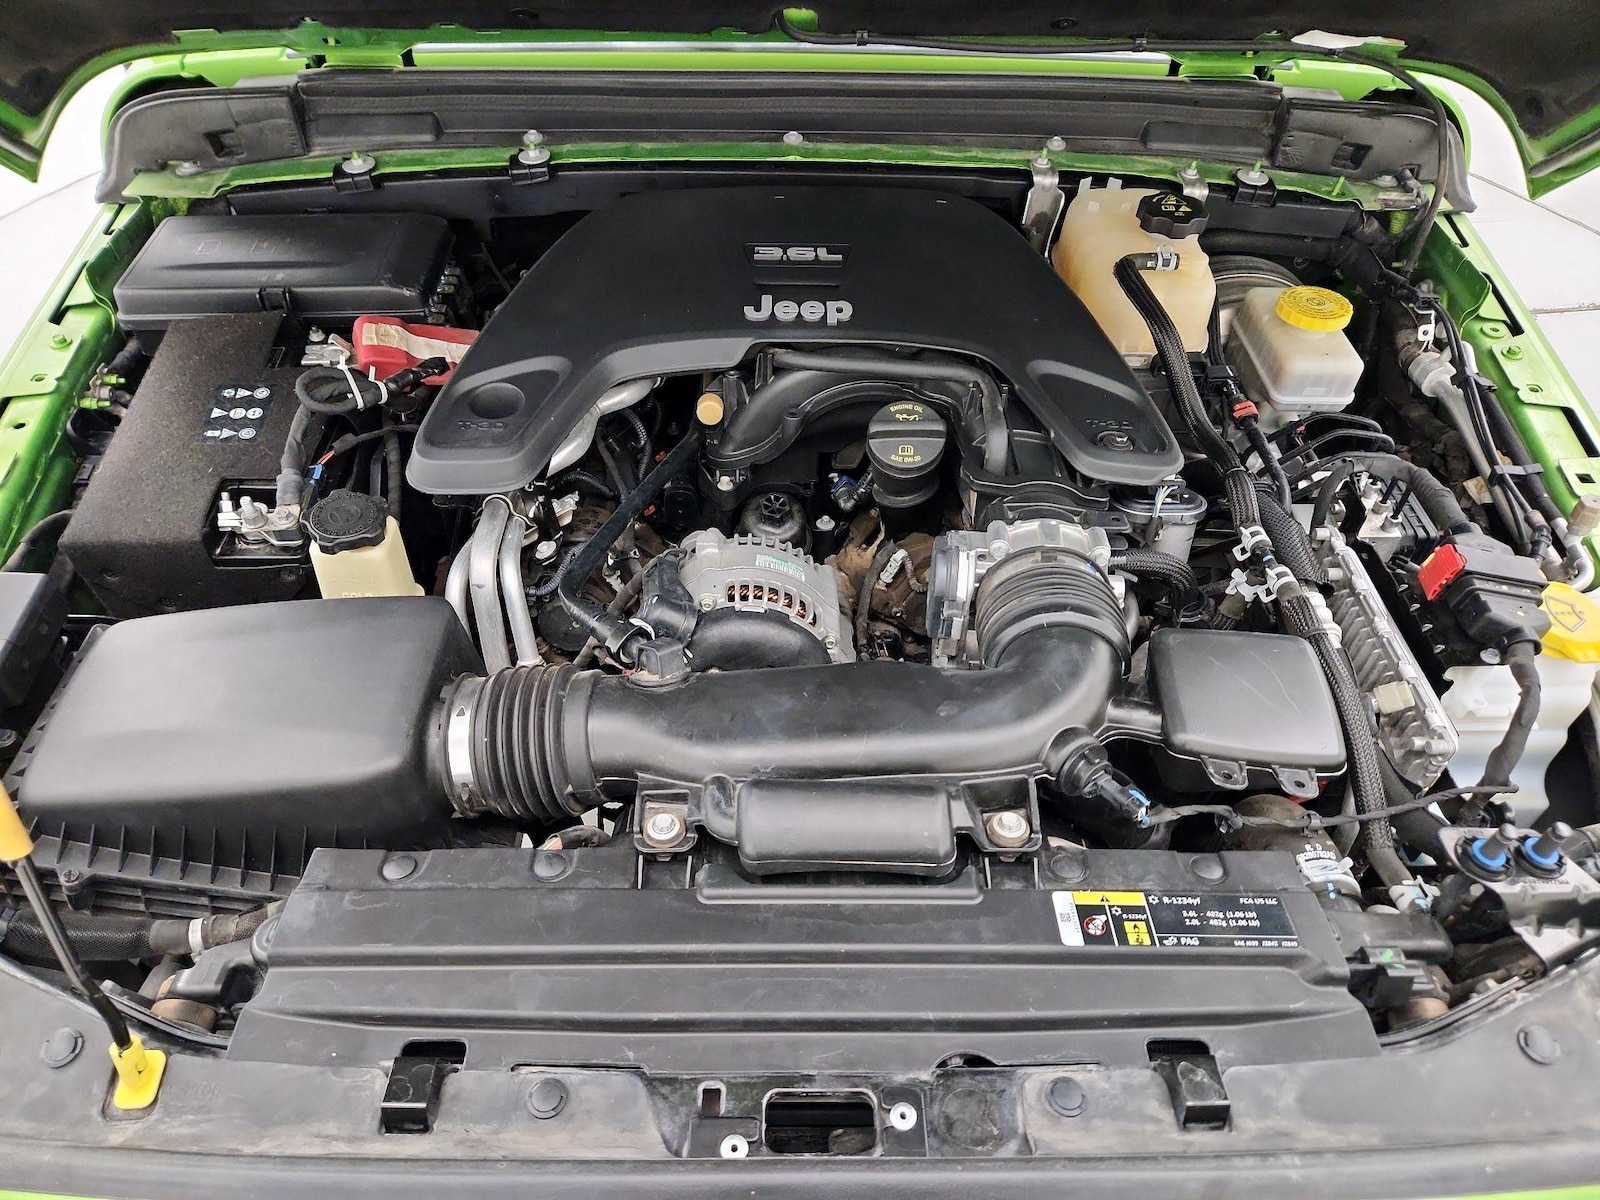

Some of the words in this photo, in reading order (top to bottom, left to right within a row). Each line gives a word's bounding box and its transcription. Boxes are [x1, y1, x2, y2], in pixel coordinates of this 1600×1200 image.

[753, 246, 843, 261] 3.6L
[743, 294, 854, 327] Jeep
[889, 404, 914, 412] ENGINE
[914, 405, 924, 413] OIL
[890, 454, 903, 463] SAE
[903, 455, 921, 463] 0W-20
[1162, 896, 1201, 906] R-1234yf
[1239, 897, 1254, 905] FCA
[1254, 897, 1265, 905] US
[1265, 897, 1279, 905] LLC
[1122, 913, 1147, 921] R-1234yf
[1181, 910, 1198, 918] 3.6L
[1205, 910, 1224, 919] 482g
[1184, 918, 1201, 926] 2.0L
[1209, 918, 1228, 927] 482g
[1180, 936, 1200, 946] PAG
